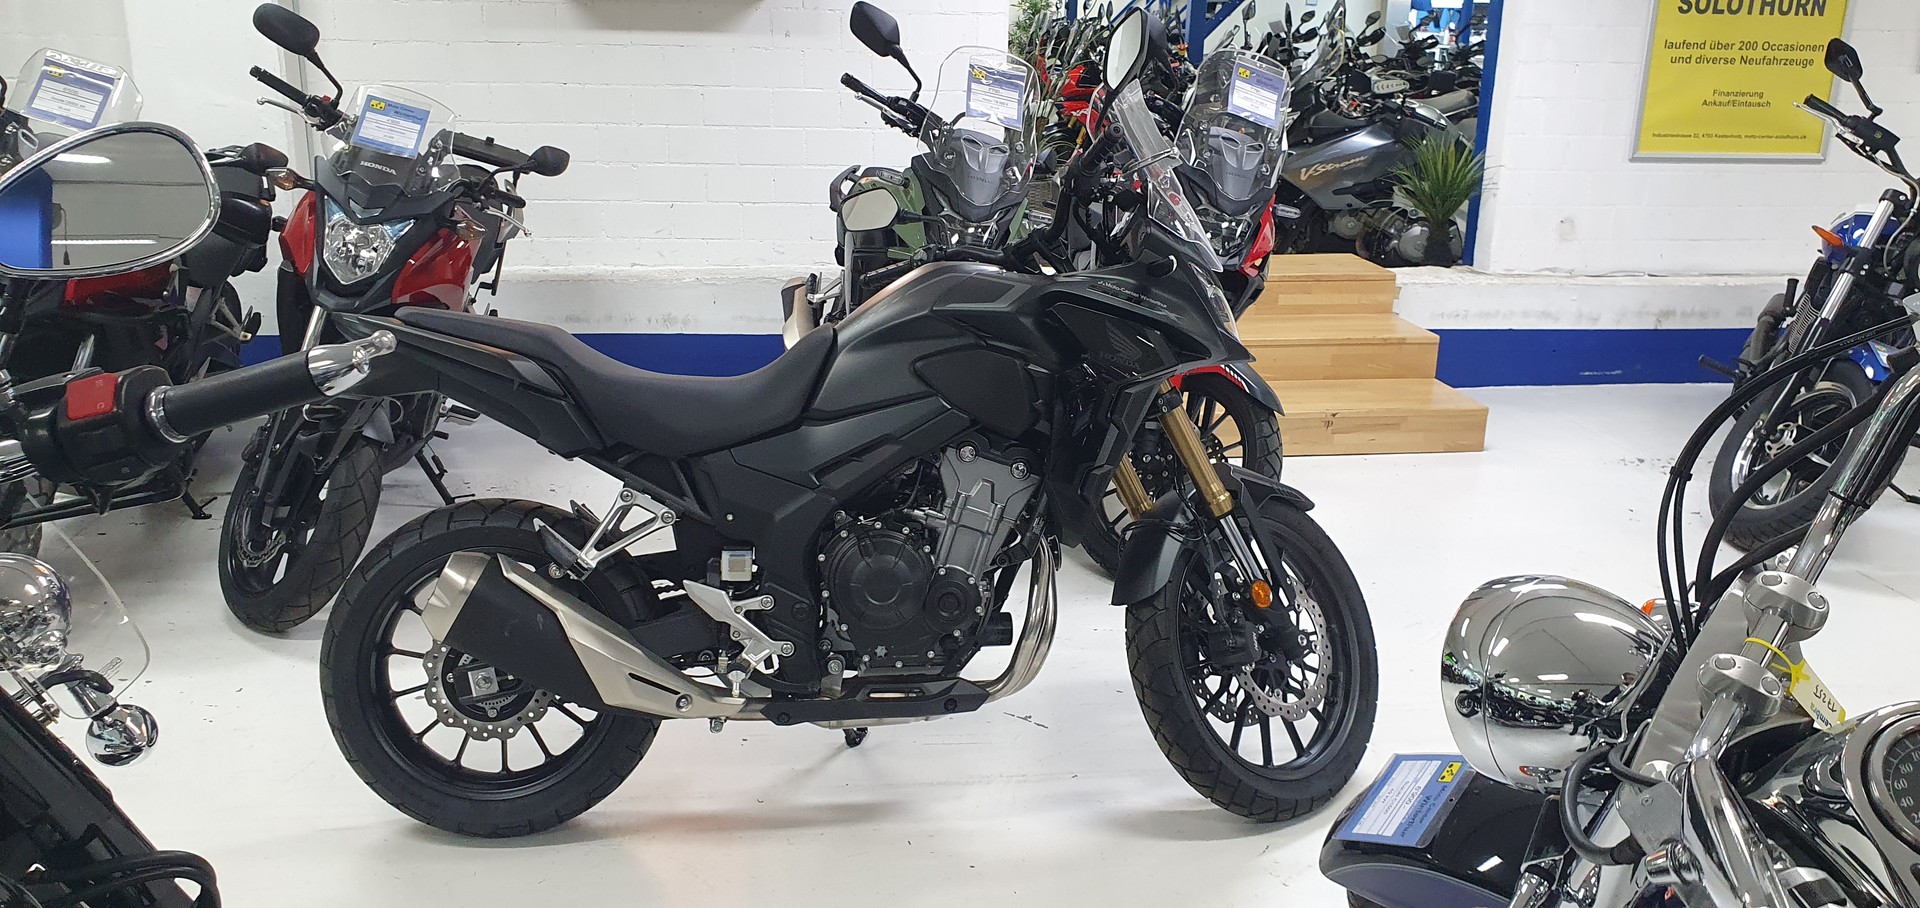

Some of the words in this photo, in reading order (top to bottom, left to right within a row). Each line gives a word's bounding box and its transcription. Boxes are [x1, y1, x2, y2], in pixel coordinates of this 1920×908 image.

[1678, 0, 1827, 17] SOLOTHURN
[1664, 38, 1706, 51] laufend
[1709, 39, 1735, 52] über
[1738, 40, 1758, 52] 200
[1761, 40, 1825, 53] Occasionen
[1670, 54, 1692, 65] und
[1695, 54, 1736, 66] diverse
[1739, 54, 1815, 69] Neufahrzeuge
[1712, 89, 1764, 99] Finanzierung
[1701, 98, 1771, 109] Ankauf/Eintausch
[360, 160, 397, 176] HONDA
[1098, 351, 1141, 371] HONDA
[1898, 762, 1913, 774] 80
[1894, 777, 1908, 791] 60
[1899, 795, 1914, 808] 40
[1399, 793, 1433, 838] Winterthur
